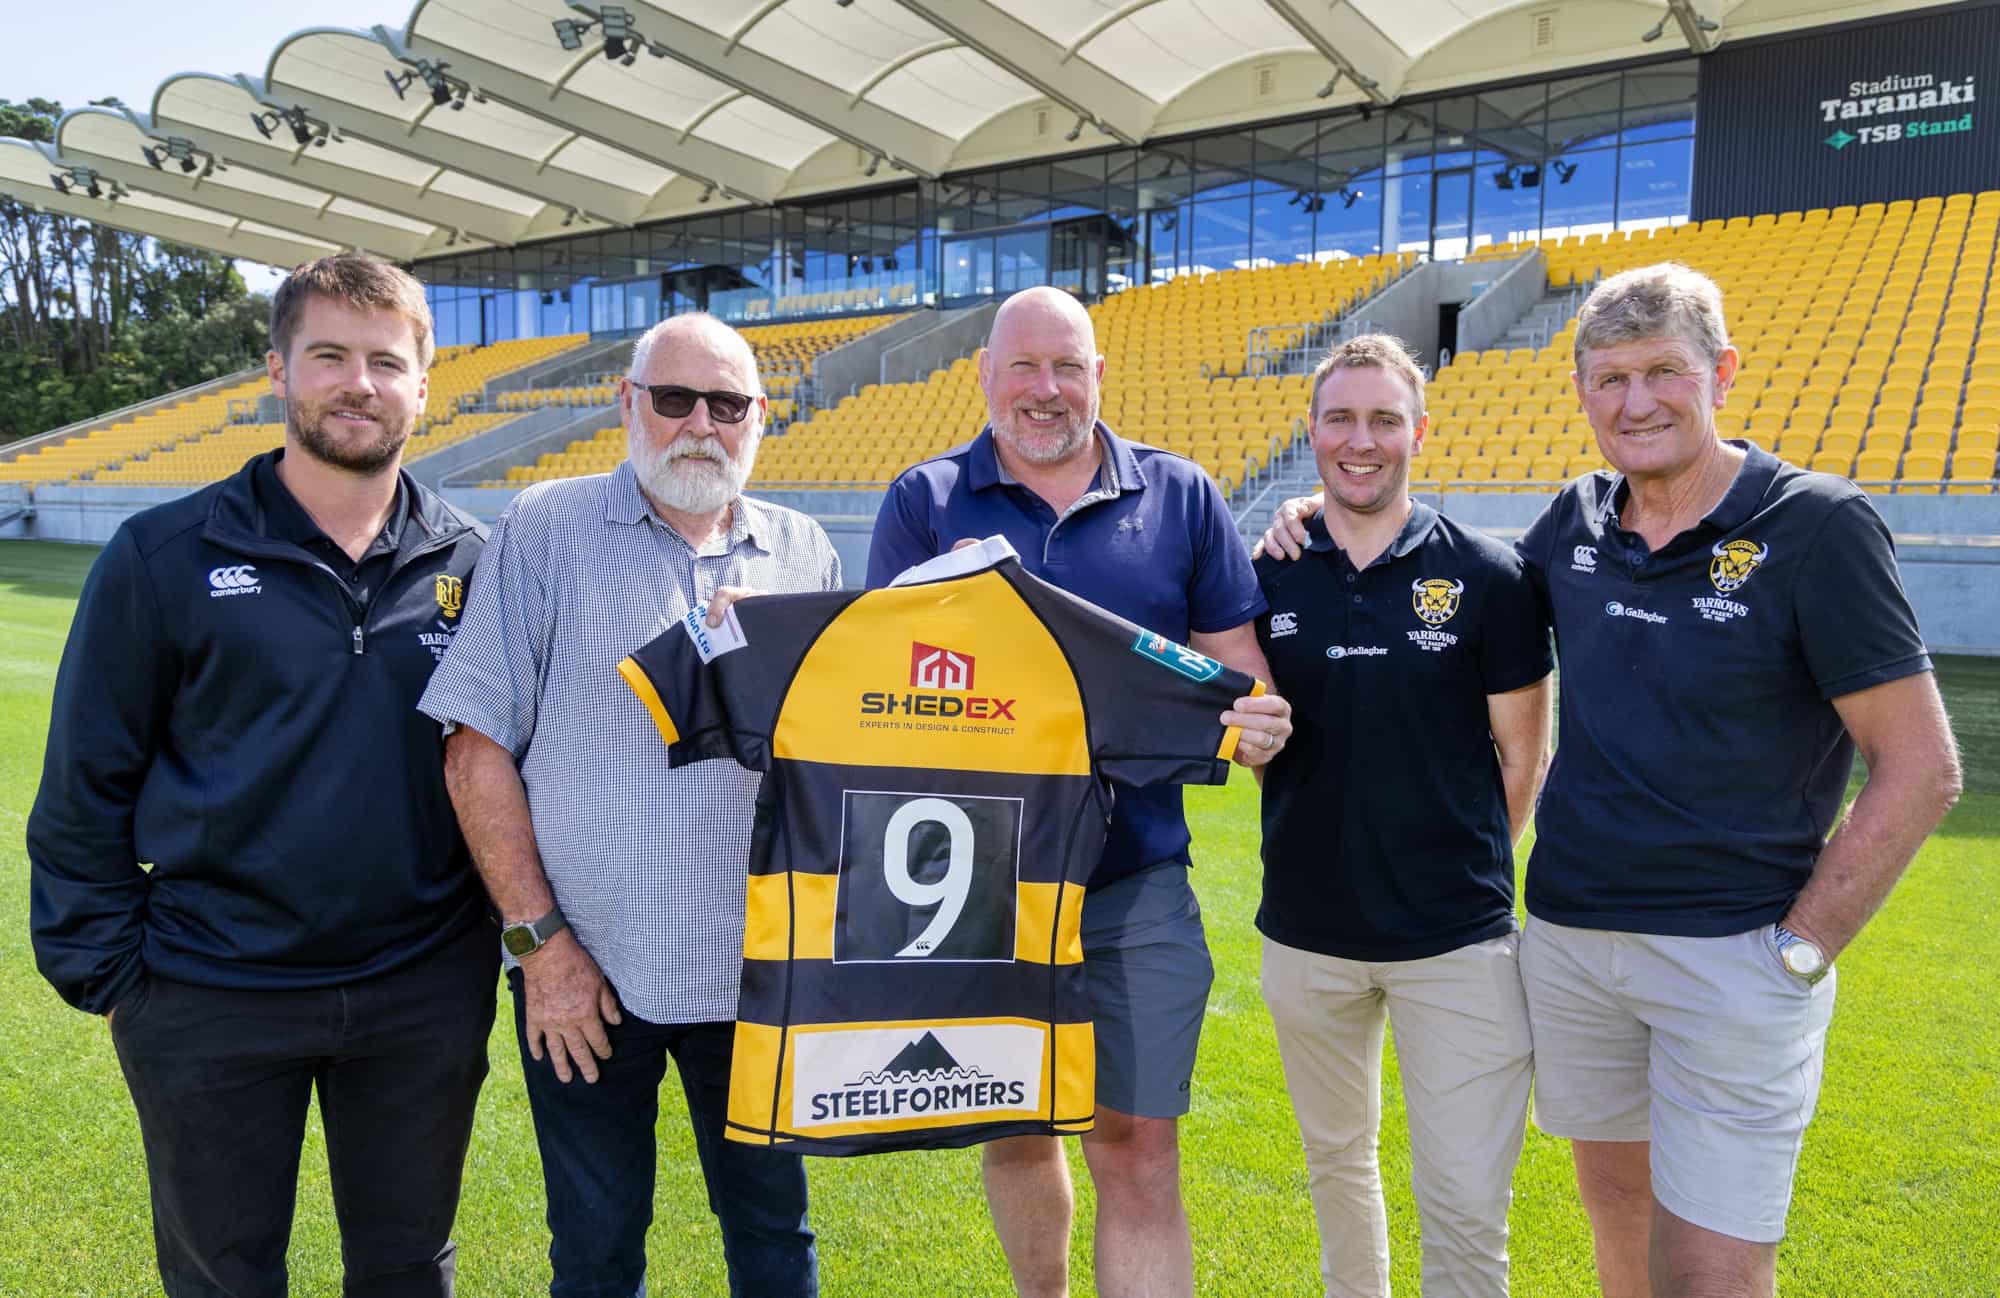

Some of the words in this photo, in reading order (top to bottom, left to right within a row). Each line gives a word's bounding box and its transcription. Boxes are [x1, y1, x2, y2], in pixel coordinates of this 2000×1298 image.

[1849, 74, 1934, 97] Stadium
[1820, 76, 1976, 122] Taranaki
[1857, 124, 1902, 144] TSB
[1905, 113, 1973, 138] Stand
[210, 585, 262, 598] canterbury
[1625, 607, 1669, 624] Gallagher
[1691, 597, 1749, 617] YARROWS
[418, 632, 450, 646] YARR
[1406, 630, 1458, 645] YARROWS
[1347, 646, 1388, 656] Gallagher
[861, 692, 1016, 720] SHEDEX
[859, 720, 900, 729] EXPERTS
[903, 722, 913, 730] IN
[915, 723, 949, 732] DESIGN
[961, 725, 1015, 735] CONSTRUCT
[884, 798, 974, 957] 9
[811, 1081, 1024, 1120] STEELFORMERS
